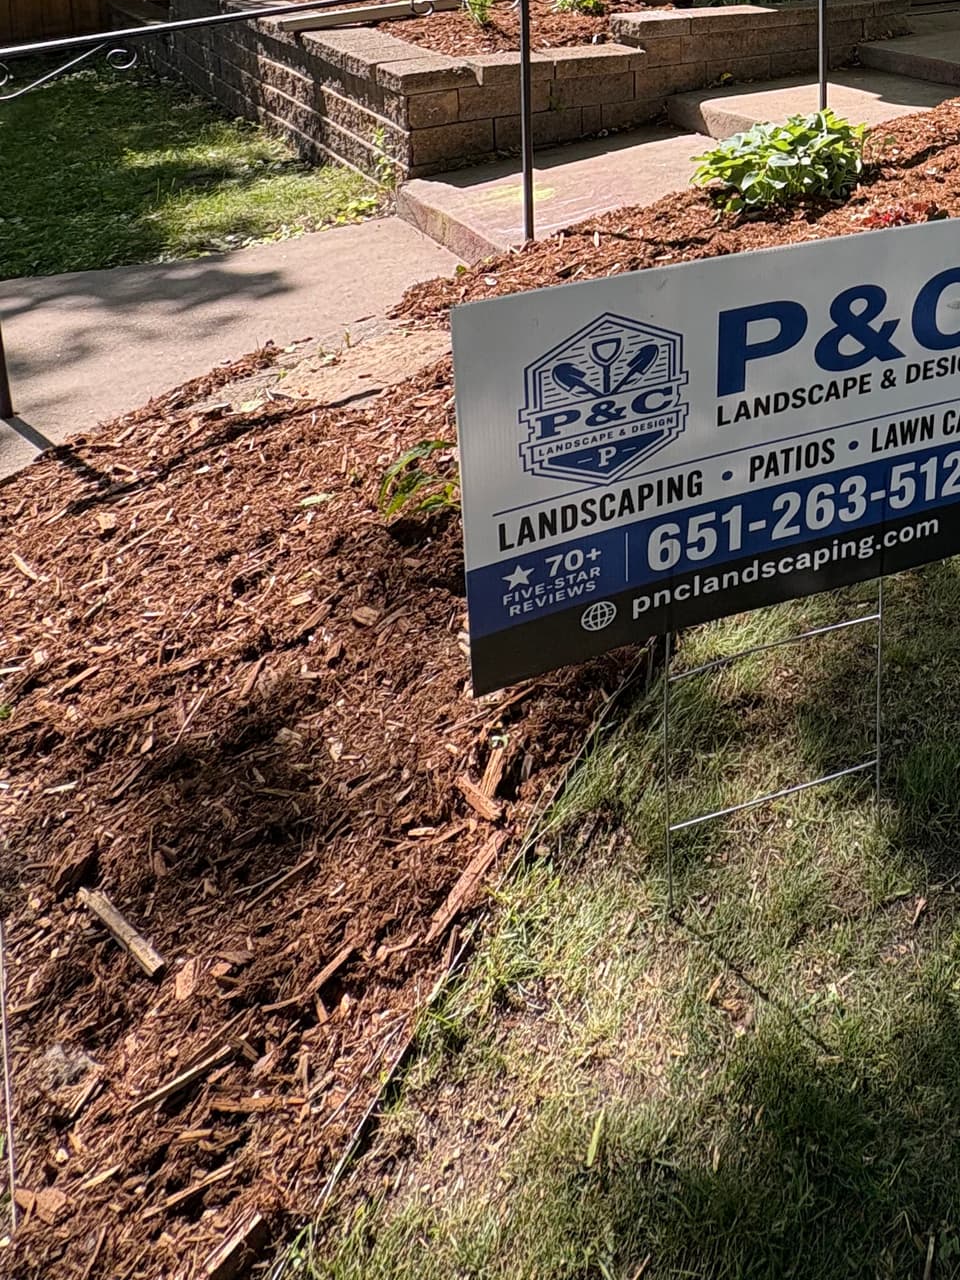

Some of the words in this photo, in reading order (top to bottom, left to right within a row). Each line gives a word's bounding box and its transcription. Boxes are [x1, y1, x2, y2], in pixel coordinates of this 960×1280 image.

[535, 386, 674, 440] P&C
[717, 373, 872, 426] LANDSCAPE
[880, 370, 898, 390] &
[538, 431, 614, 457] LANDSCAPE
[619, 428, 627, 436] &
[632, 416, 674, 433] DESIGN
[598, 446, 617, 467] P
[498, 470, 704, 552] LANDSCAPING
[749, 437, 836, 483] PATIOS
[871, 413, 936, 454] LAWN
[545, 546, 602, 579] 70+
[631, 515, 940, 620] pnclandscaping.com
[503, 567, 601, 607] FIVE-STAR
[508, 580, 597, 618] REVIEWS
